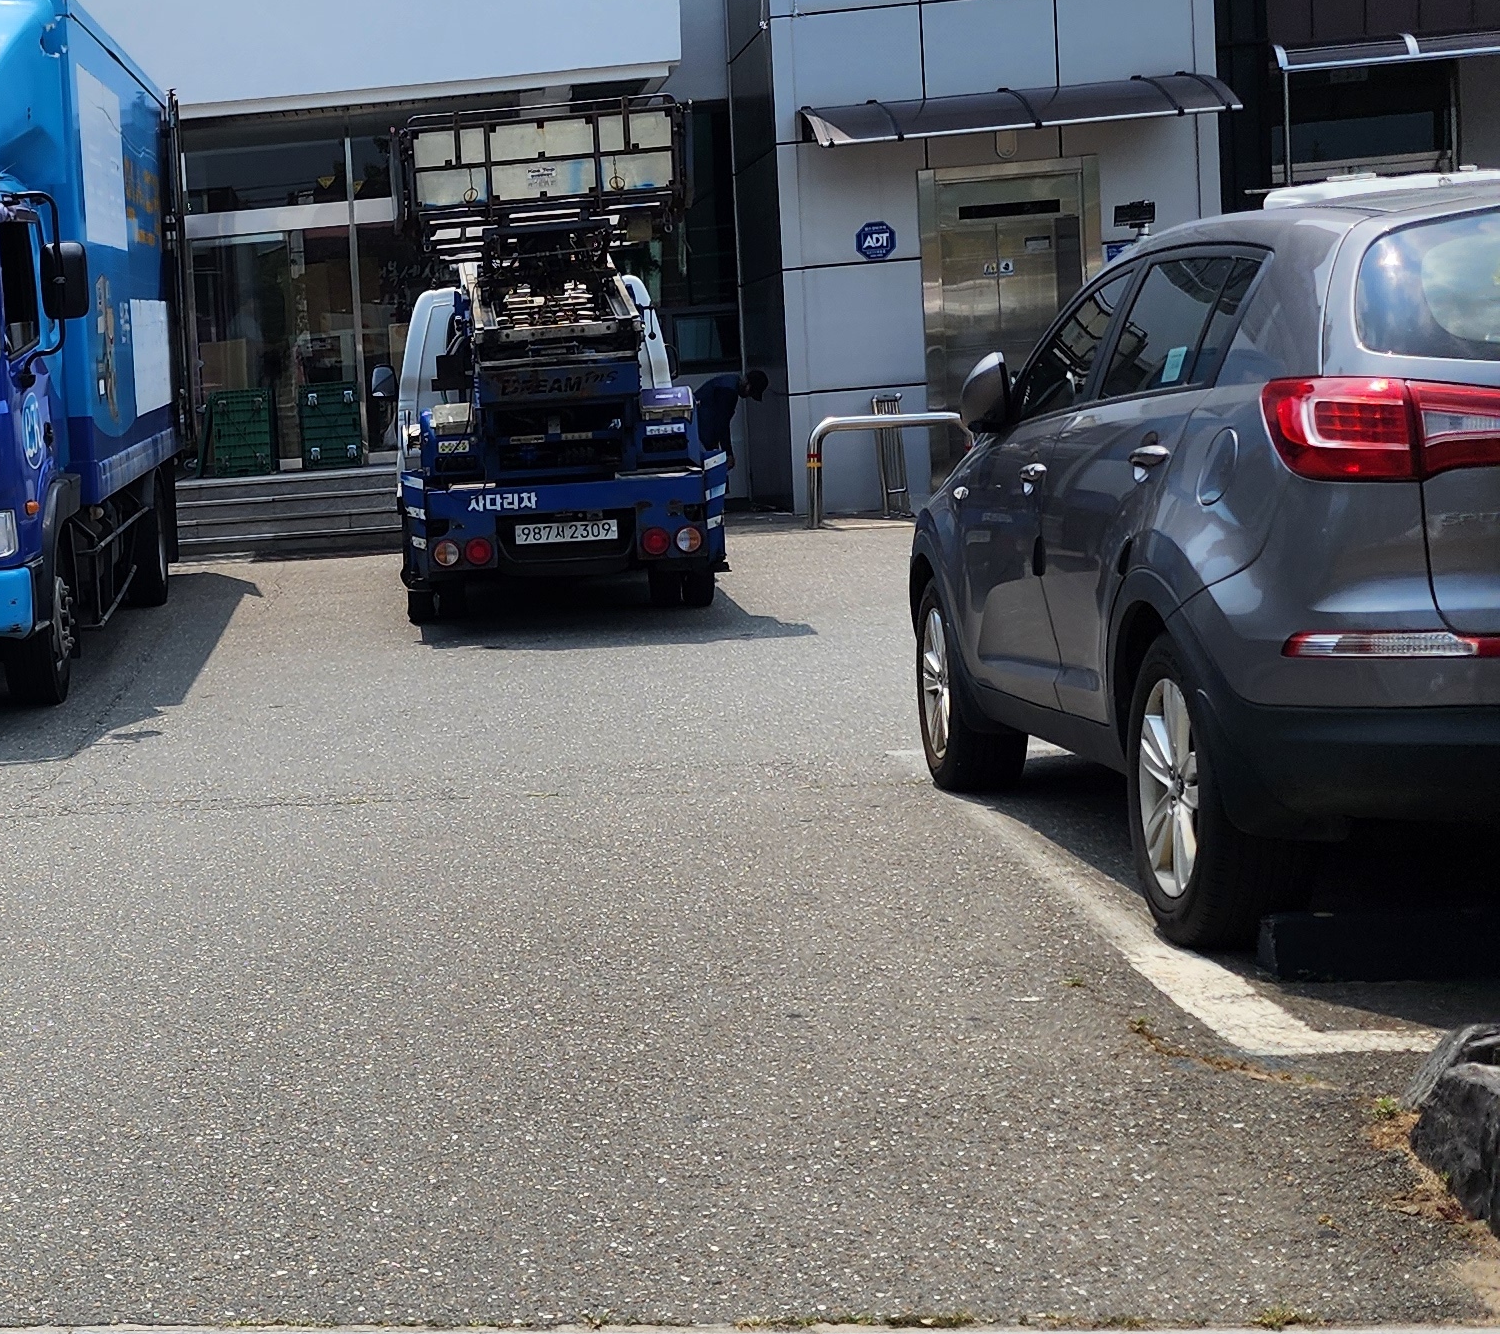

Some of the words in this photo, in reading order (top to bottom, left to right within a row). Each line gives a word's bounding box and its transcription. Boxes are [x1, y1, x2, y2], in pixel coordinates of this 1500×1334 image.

[862, 232, 890, 249] ADT
[467, 491, 538, 512] 사다리차
[521, 522, 612, 543] 987서2309
